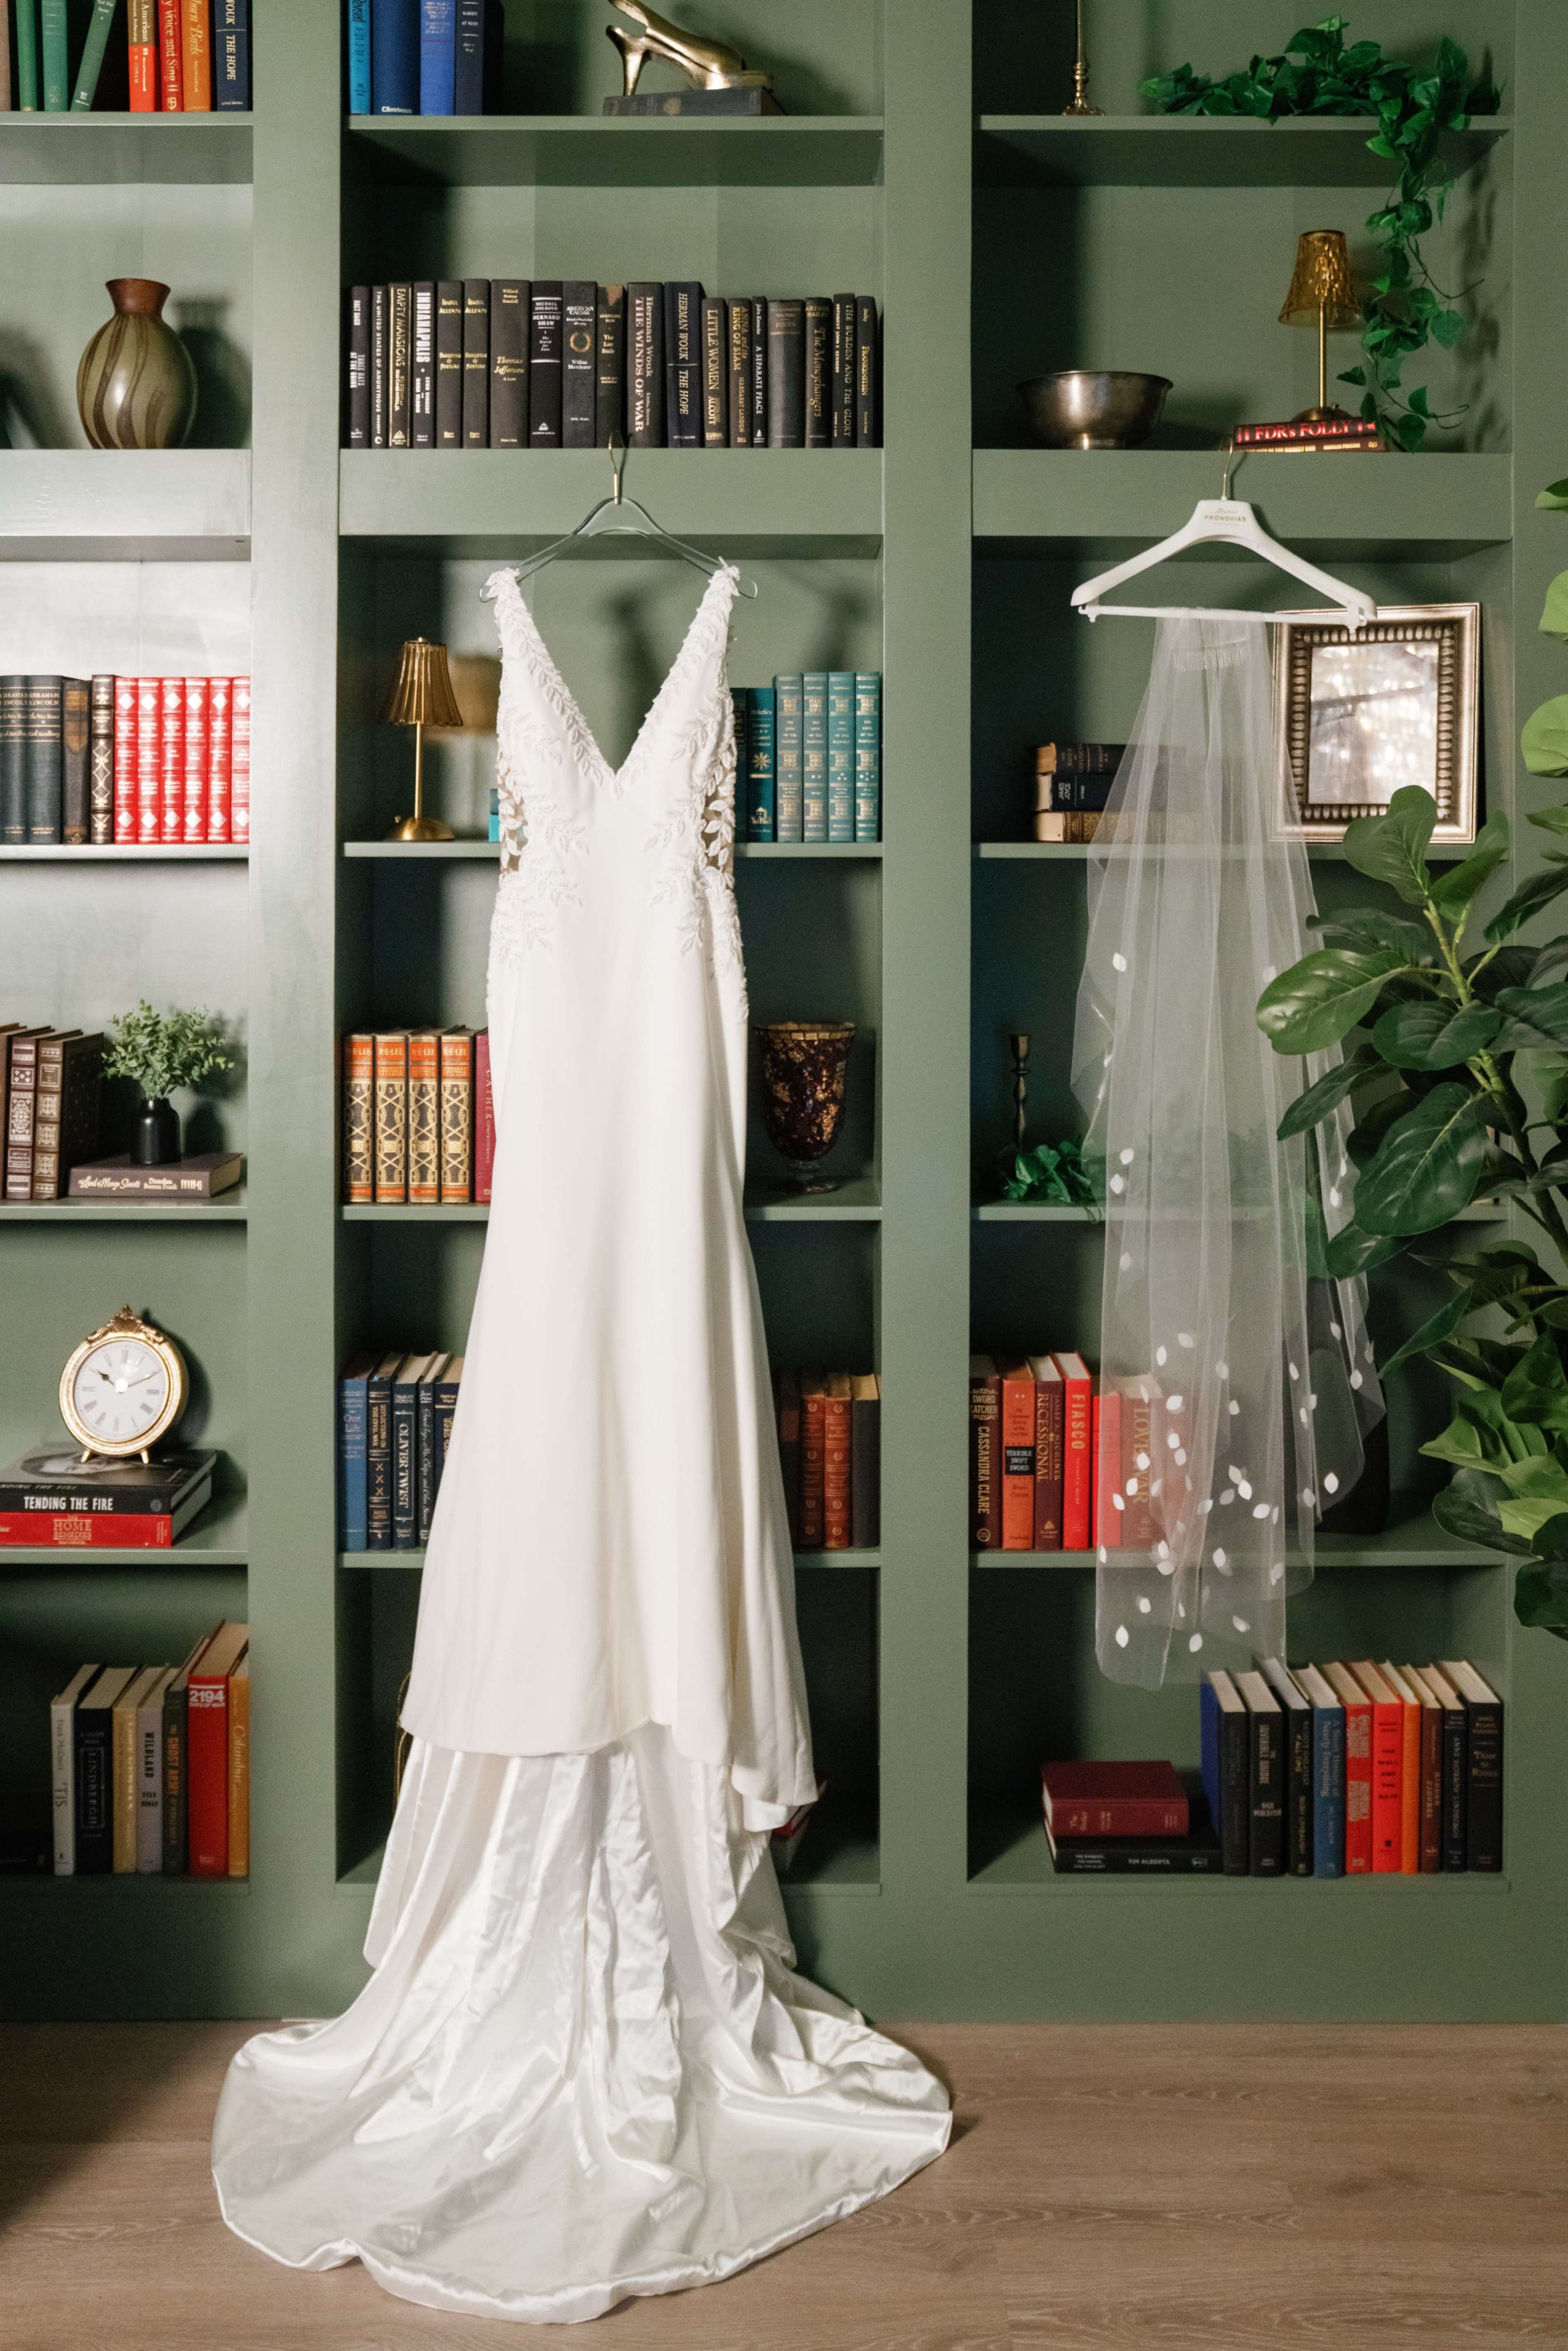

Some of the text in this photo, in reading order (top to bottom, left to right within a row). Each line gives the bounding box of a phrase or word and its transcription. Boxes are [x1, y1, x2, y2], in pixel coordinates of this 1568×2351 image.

[142, 4, 150, 42] American
[164, 9, 177, 36] Voice
[164, 40, 177, 57] and
[189, 25, 203, 56] Birds
[164, 59, 177, 81] Sing
[226, 35, 236, 80] THE HOPE
[395, 288, 405, 367] EMPTY MANSIONS
[416, 292, 431, 363] INDIANAPOLIS
[646, 297, 654, 377] Herman Wouk
[679, 292, 688, 360] HERMAN WOUK
[733, 332, 741, 345] OF
[376, 359, 382, 368] OF
[635, 297, 644, 432] THE WINDS OF WAR
[707, 309, 719, 390] LITTLE WOMEN
[493, 366, 524, 375] Jefferson
[810, 327, 825, 417] The Moneychangers
[844, 303, 853, 437] THE BURDEN AND THE GLORY
[862, 346, 870, 396] FRANKENSTEIN
[679, 370, 688, 414] THE HOPE
[1254, 425, 1296, 441] FDR's
[1299, 421, 1350, 437] FOLLY
[972, 1395, 996, 1404] SWORD
[343, 1414, 362, 1423] One
[1071, 1394, 1086, 1450] FIASCO
[1133, 1407, 1152, 1455] LOVE
[380, 1440, 386, 1448] ON
[421, 1442, 431, 1457] Mr.
[1037, 1393, 1049, 1482] RECESSIONAL
[399, 1423, 409, 1508] OLIVER TWIST
[421, 1458, 431, 1476] Chips
[978, 1426, 990, 1514] CASSANDRA CLARE
[23, 1496, 114, 1511] TENDING THE FIRE
[53, 1521, 92, 1531] HOME
[189, 1690, 224, 1703] 2194
[145, 1732, 155, 1778] WILDLAND
[168, 1737, 179, 1767] GHOST
[1332, 1730, 1341, 1752] Short
[1259, 1760, 1270, 1784] BRIDGE
[1321, 1720, 1331, 1797] Nearly Everything
[1332, 1754, 1341, 1785] History
[54, 1782, 68, 1808] 'TIS
[88, 1751, 98, 1825] LINDBERGH
[168, 1769, 179, 1795] ARMY
